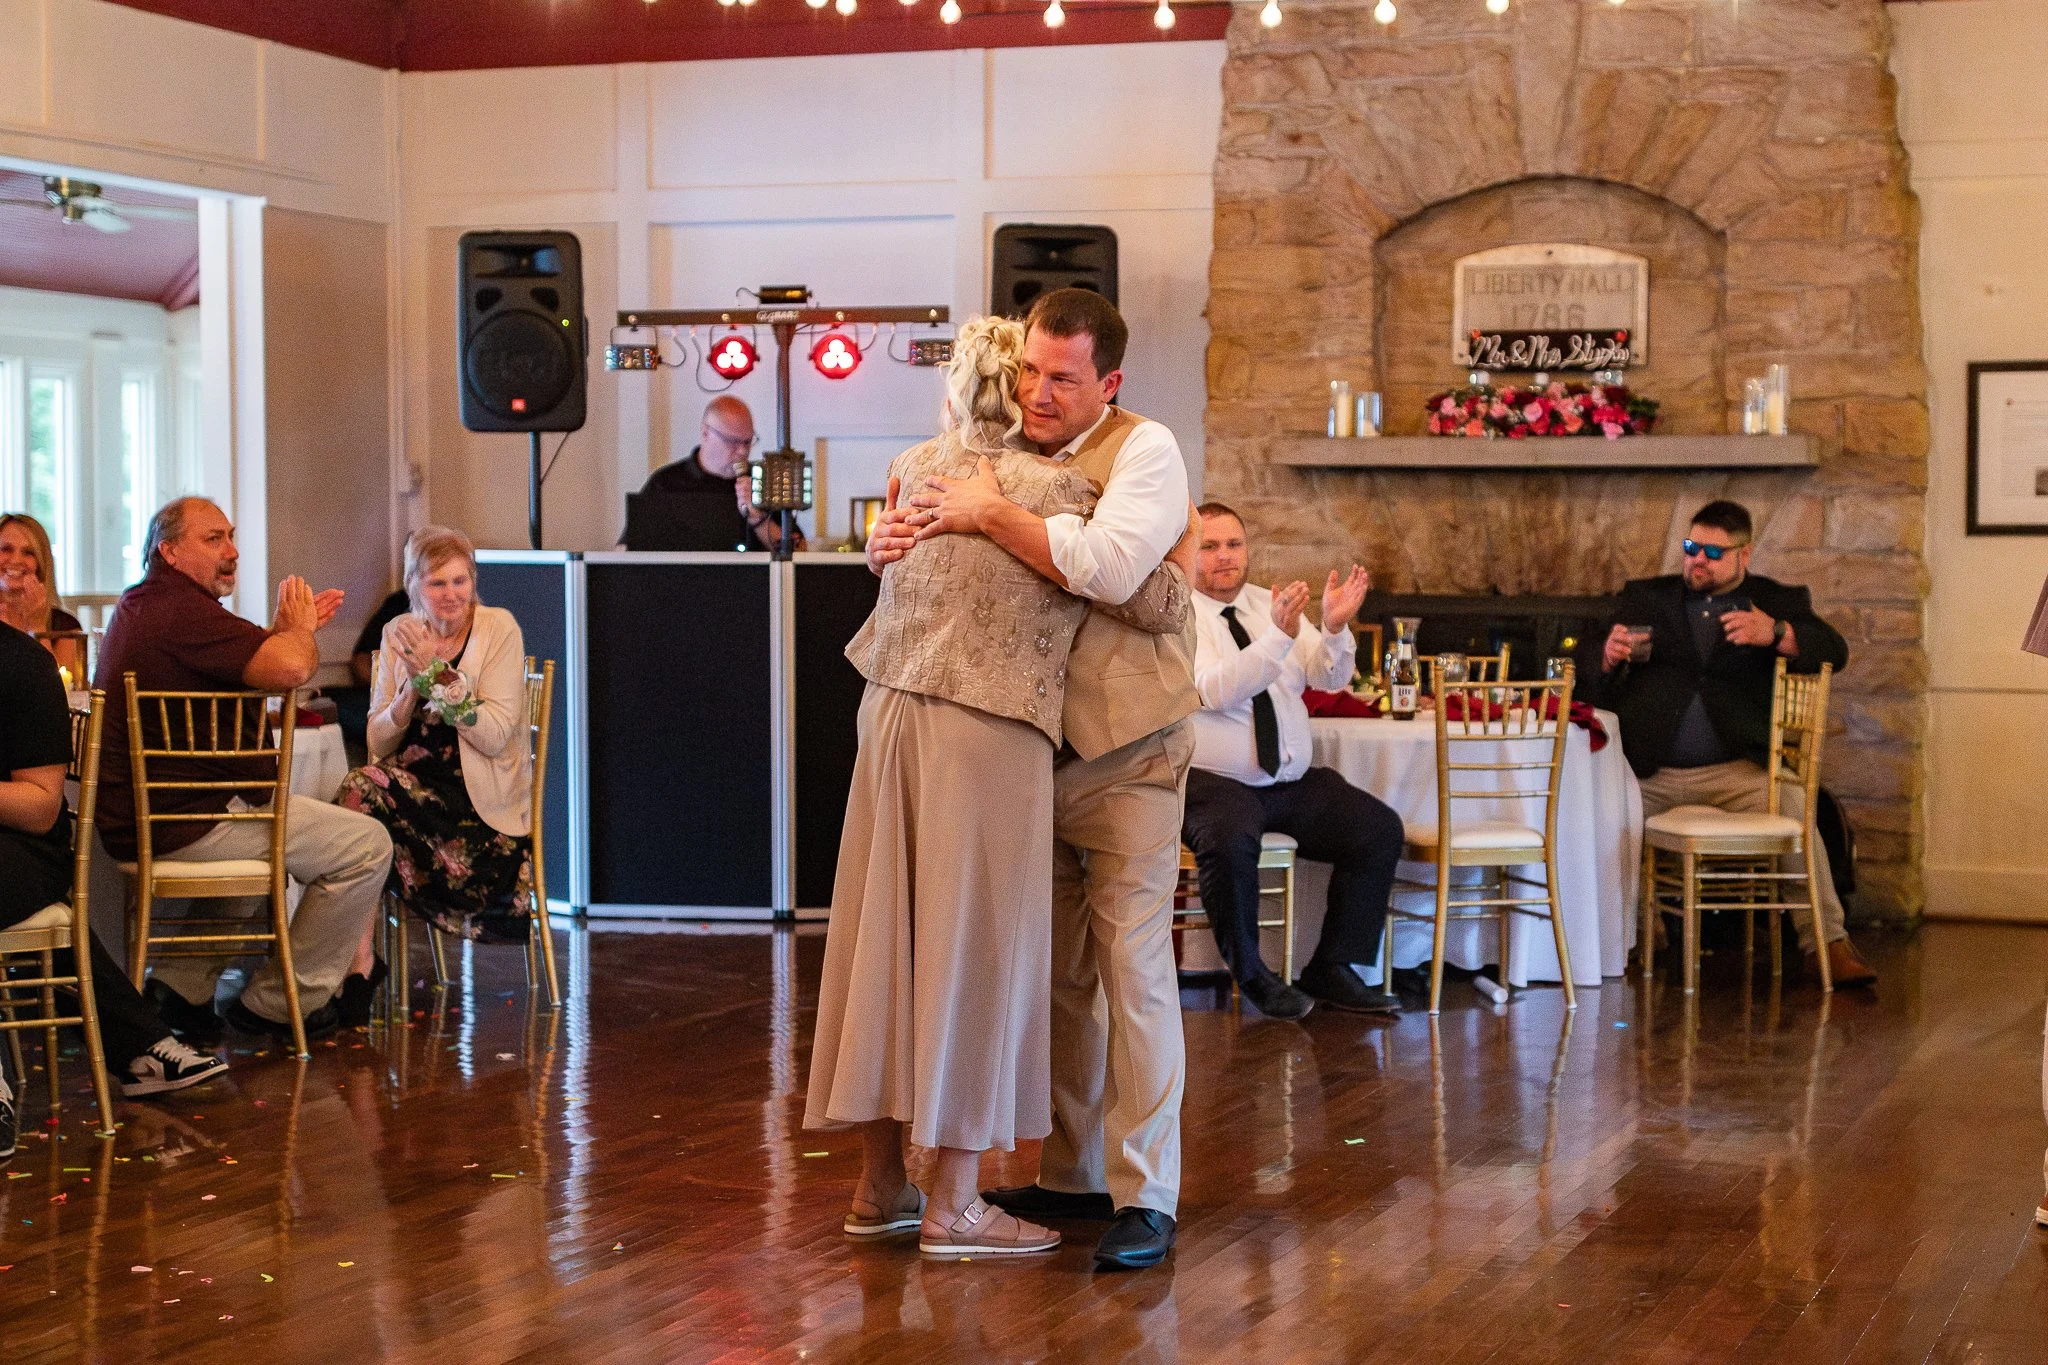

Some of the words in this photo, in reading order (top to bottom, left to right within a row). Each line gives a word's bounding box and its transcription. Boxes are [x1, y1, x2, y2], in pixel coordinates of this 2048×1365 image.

[1471, 272, 1565, 296] LIBERTY
[1569, 272, 1632, 296] HALL
[1511, 302, 1586, 329] 1786
[1510, 339, 1530, 363] &
